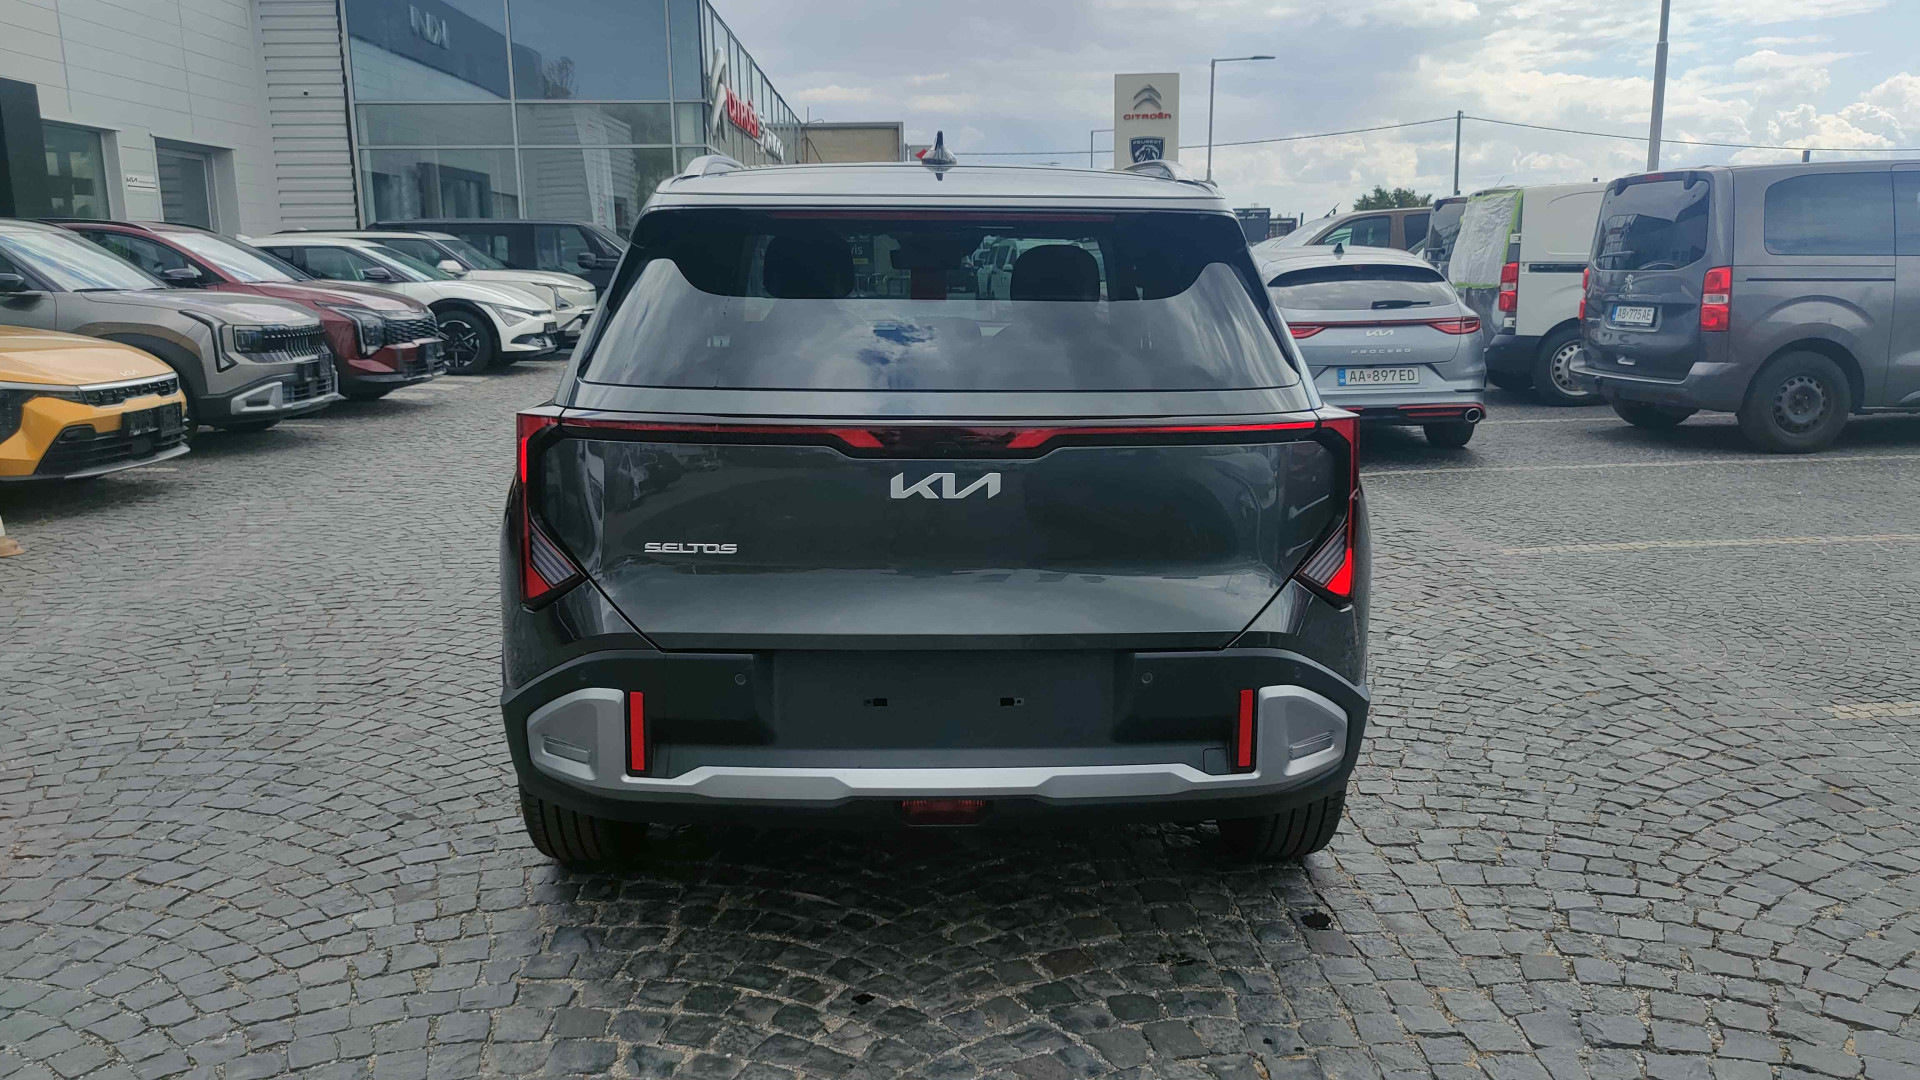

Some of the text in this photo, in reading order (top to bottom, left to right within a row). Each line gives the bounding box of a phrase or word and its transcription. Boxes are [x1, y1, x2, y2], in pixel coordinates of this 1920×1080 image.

[1366, 329, 1394, 337] KIA
[890, 472, 1001, 499] KIA
[644, 542, 738, 555] SELTOS
